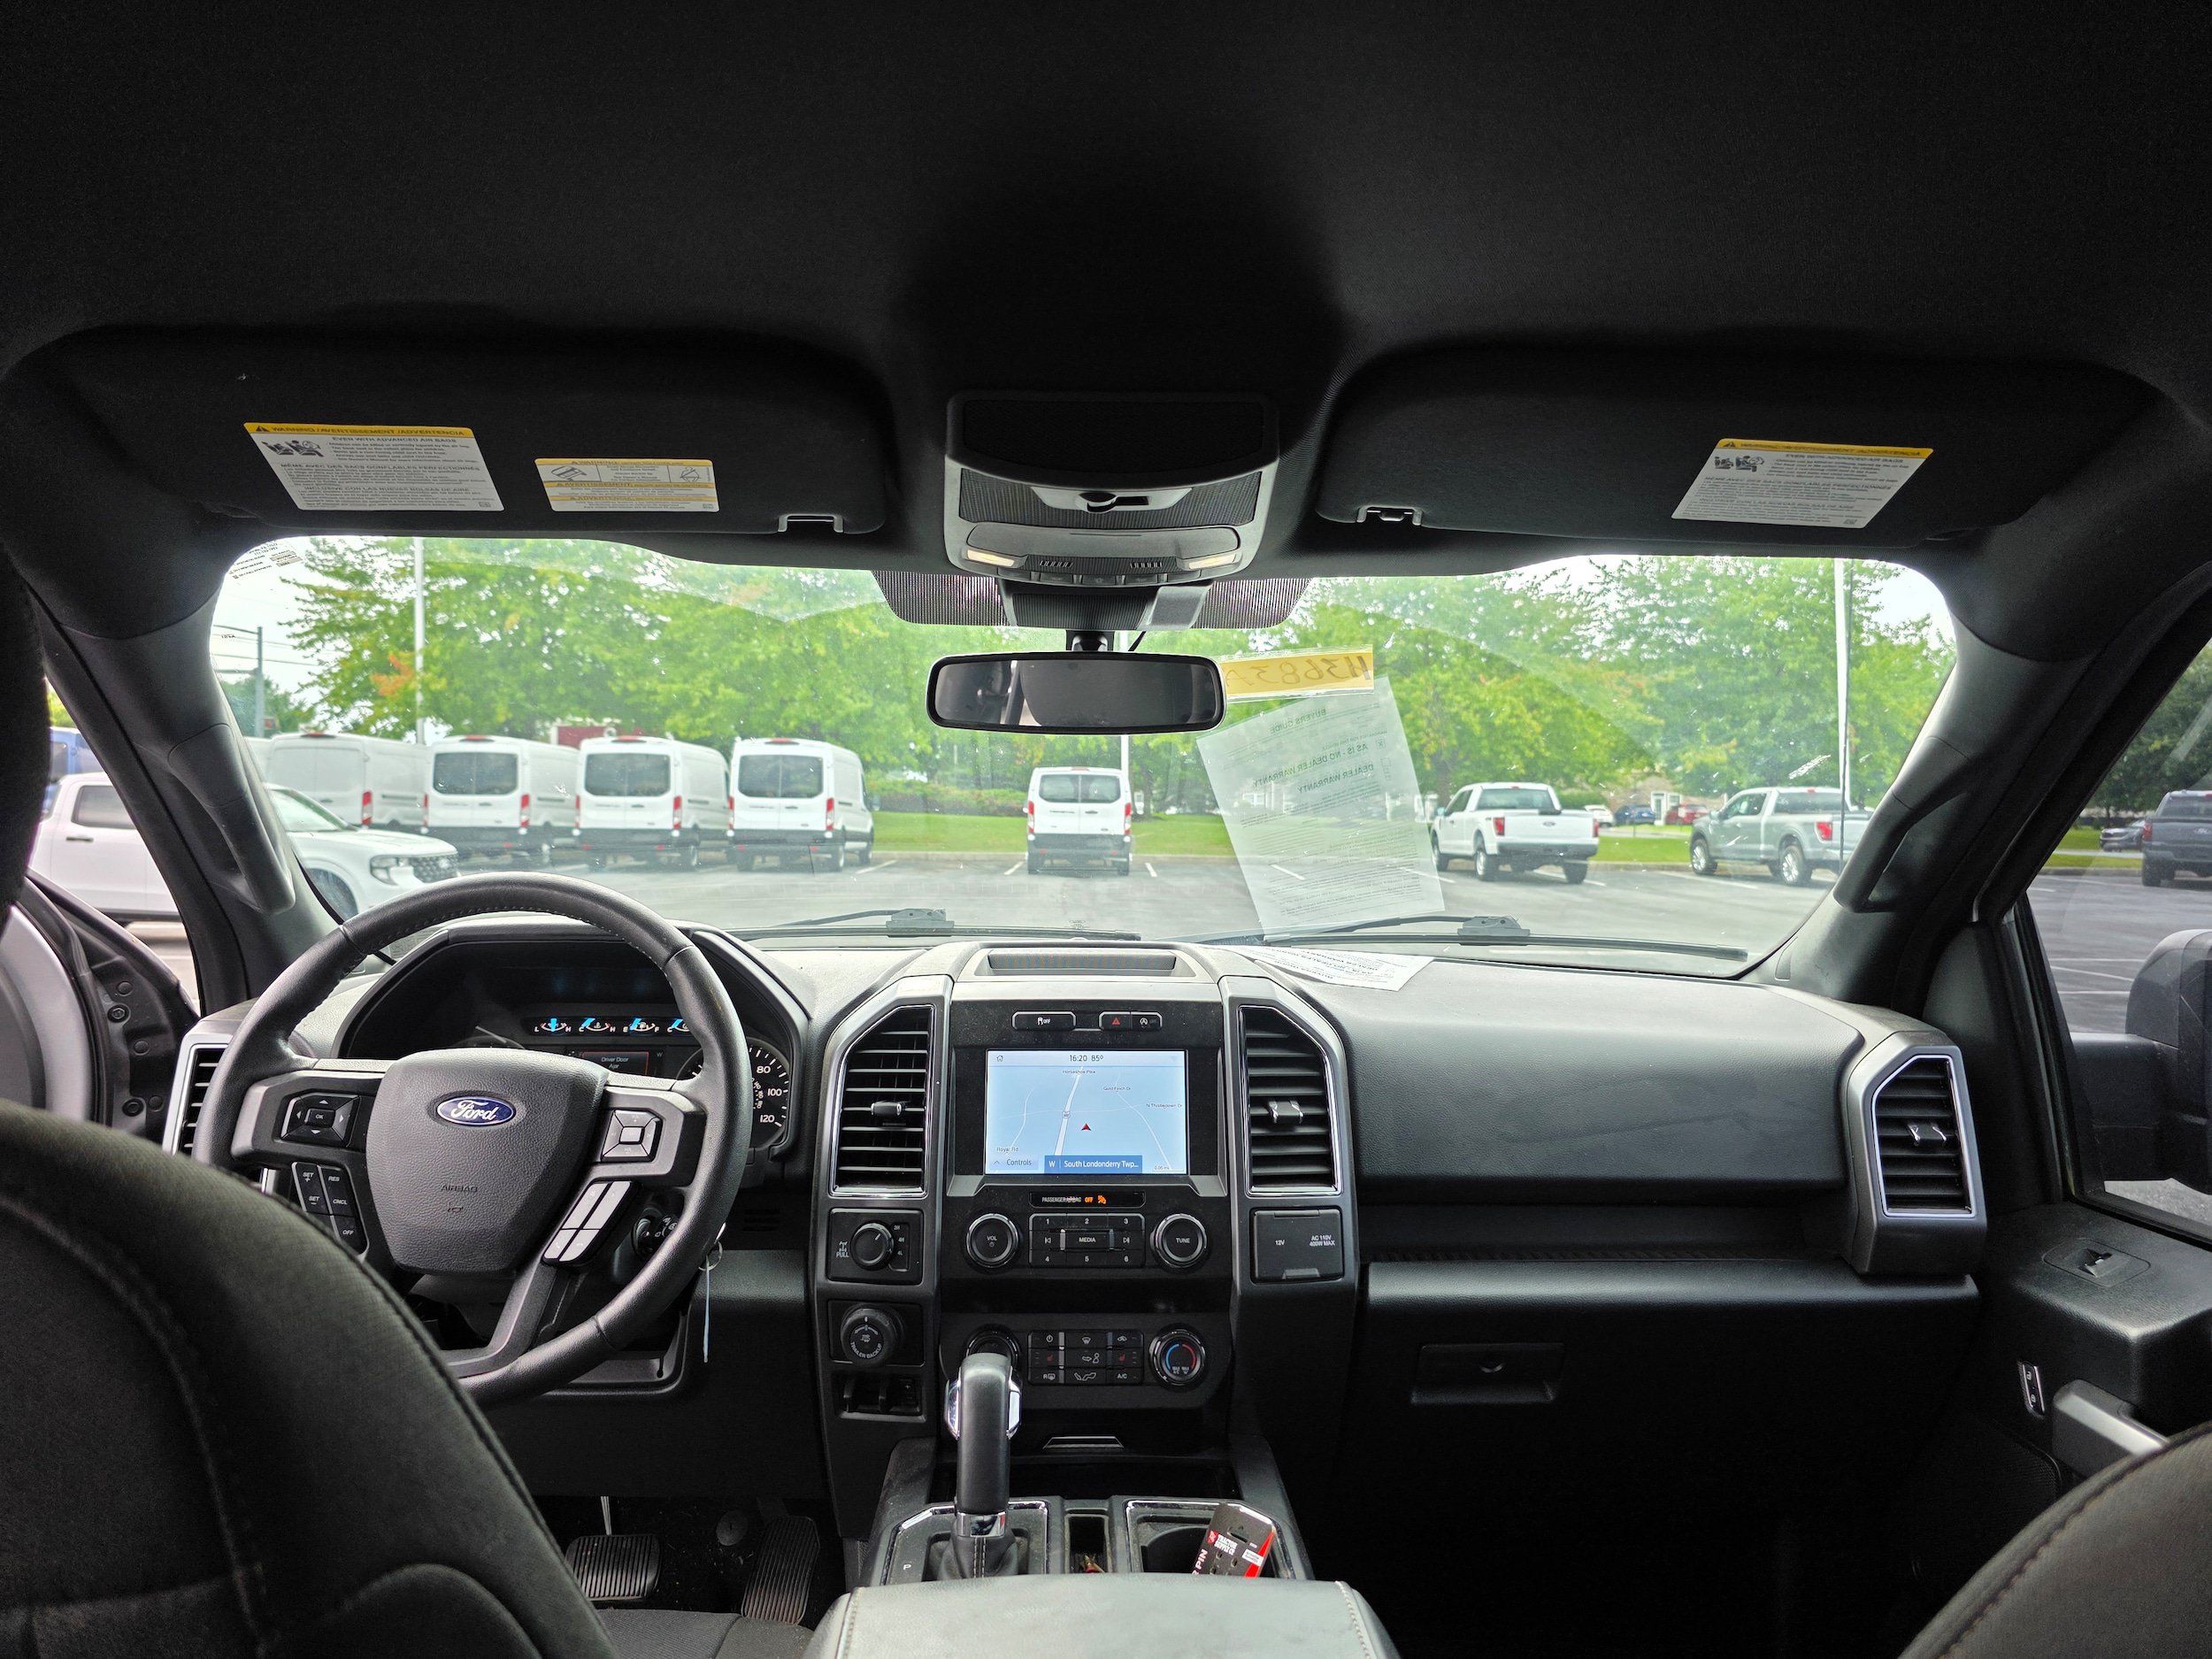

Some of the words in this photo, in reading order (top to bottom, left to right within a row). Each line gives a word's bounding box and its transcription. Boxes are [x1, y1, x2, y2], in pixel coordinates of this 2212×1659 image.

[451, 1100, 499, 1120] Ford
[1083, 1160, 1120, 1169] Londonderry
[850, 1341, 866, 1358] TRAILER
[866, 1343, 882, 1359] BACKUP
[1214, 1541, 1230, 1554] SUPPLY
[1217, 1534, 1238, 1550] TRACTOR
[1195, 1549, 1208, 1570] PIN
